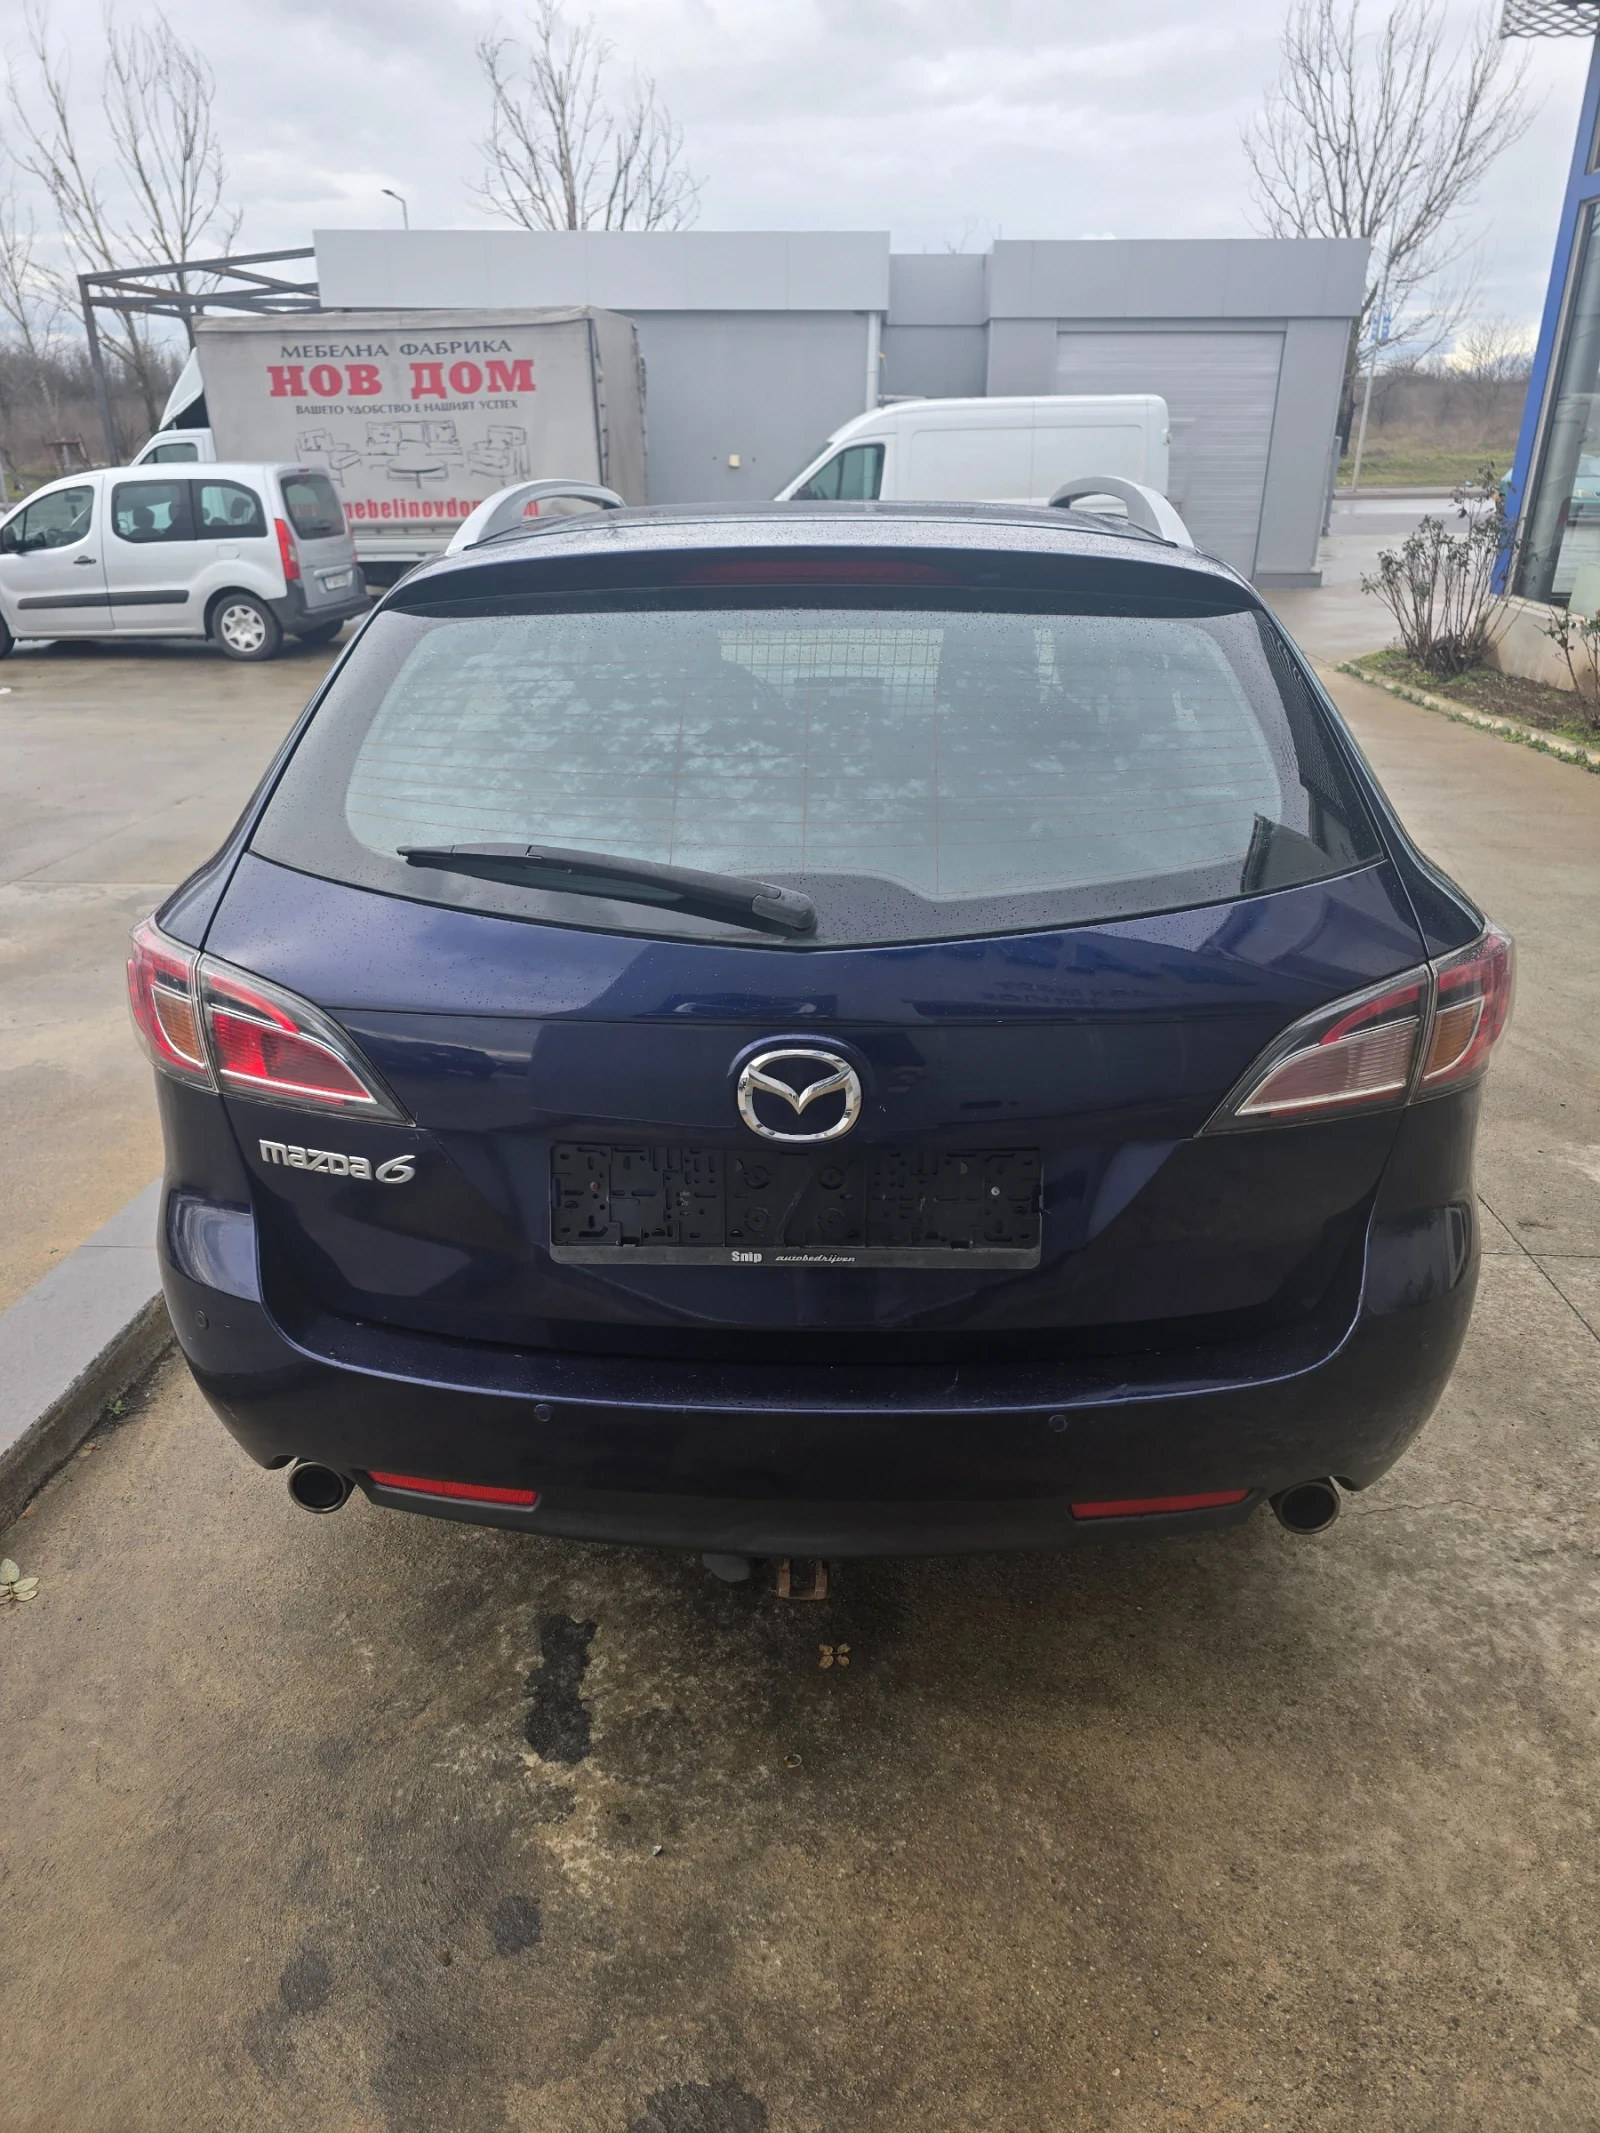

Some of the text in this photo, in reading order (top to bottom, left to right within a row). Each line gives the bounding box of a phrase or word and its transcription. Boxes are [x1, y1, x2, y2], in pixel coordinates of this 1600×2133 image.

[280, 339, 513, 358] МЕБЕЛНА ФАБРИКА
[266, 359, 537, 400] НОВ ДОМ
[295, 399, 518, 415] ВАШЕТО УДОБСТВО Е НАШИЯТ УСПЕХ
[731, 1251, 856, 1264] Snip autobedrijven
